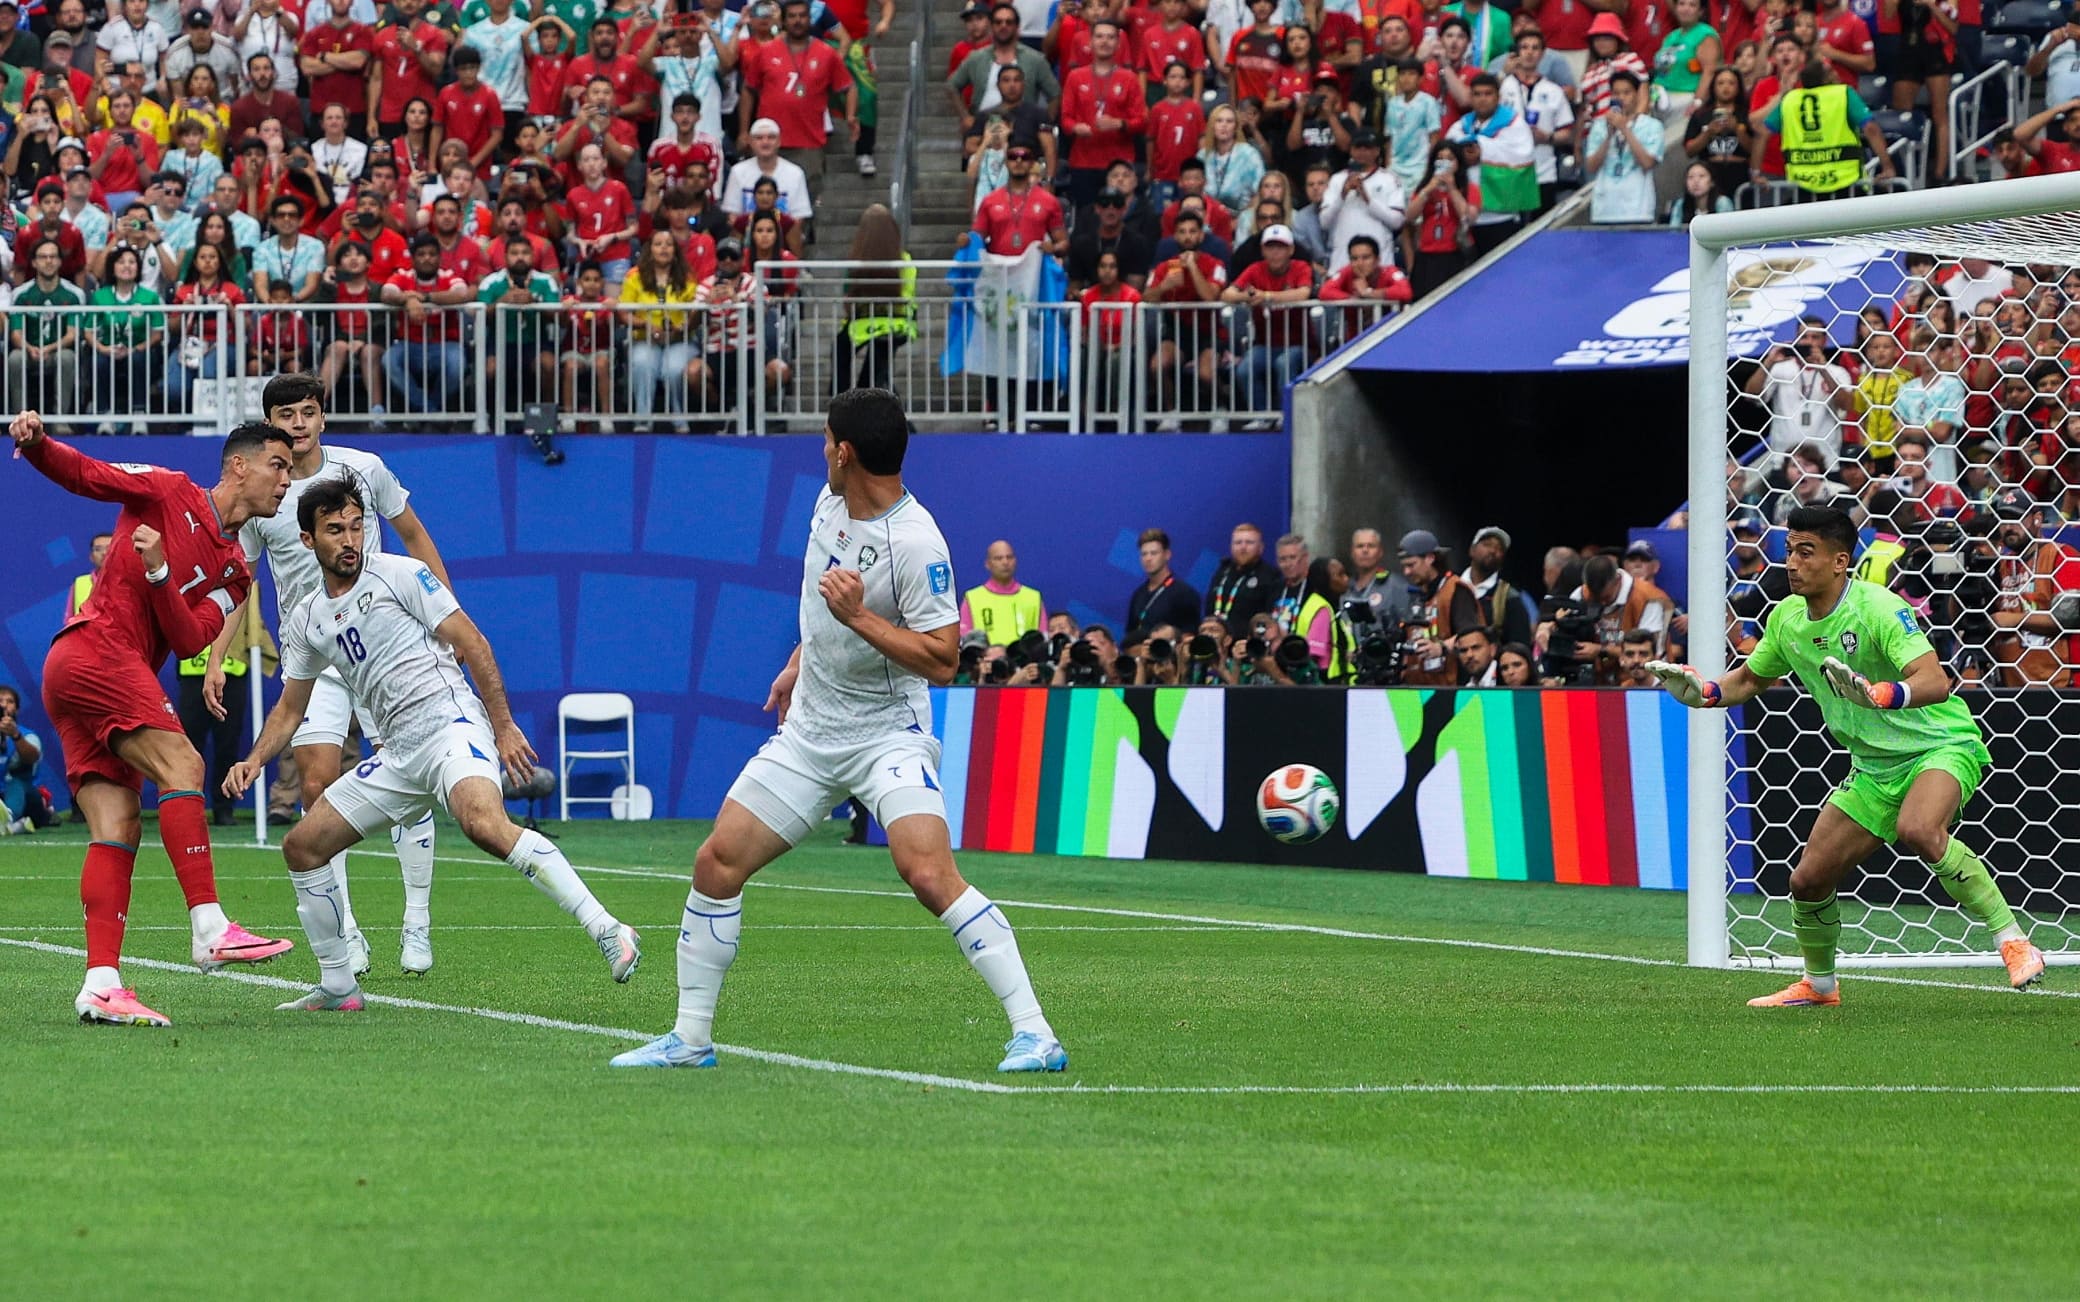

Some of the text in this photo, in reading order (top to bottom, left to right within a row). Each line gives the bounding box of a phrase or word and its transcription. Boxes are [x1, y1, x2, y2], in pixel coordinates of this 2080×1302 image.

[785, 72, 798, 93] 7
[179, 565, 207, 595] 7
[336, 626, 367, 668] 18
